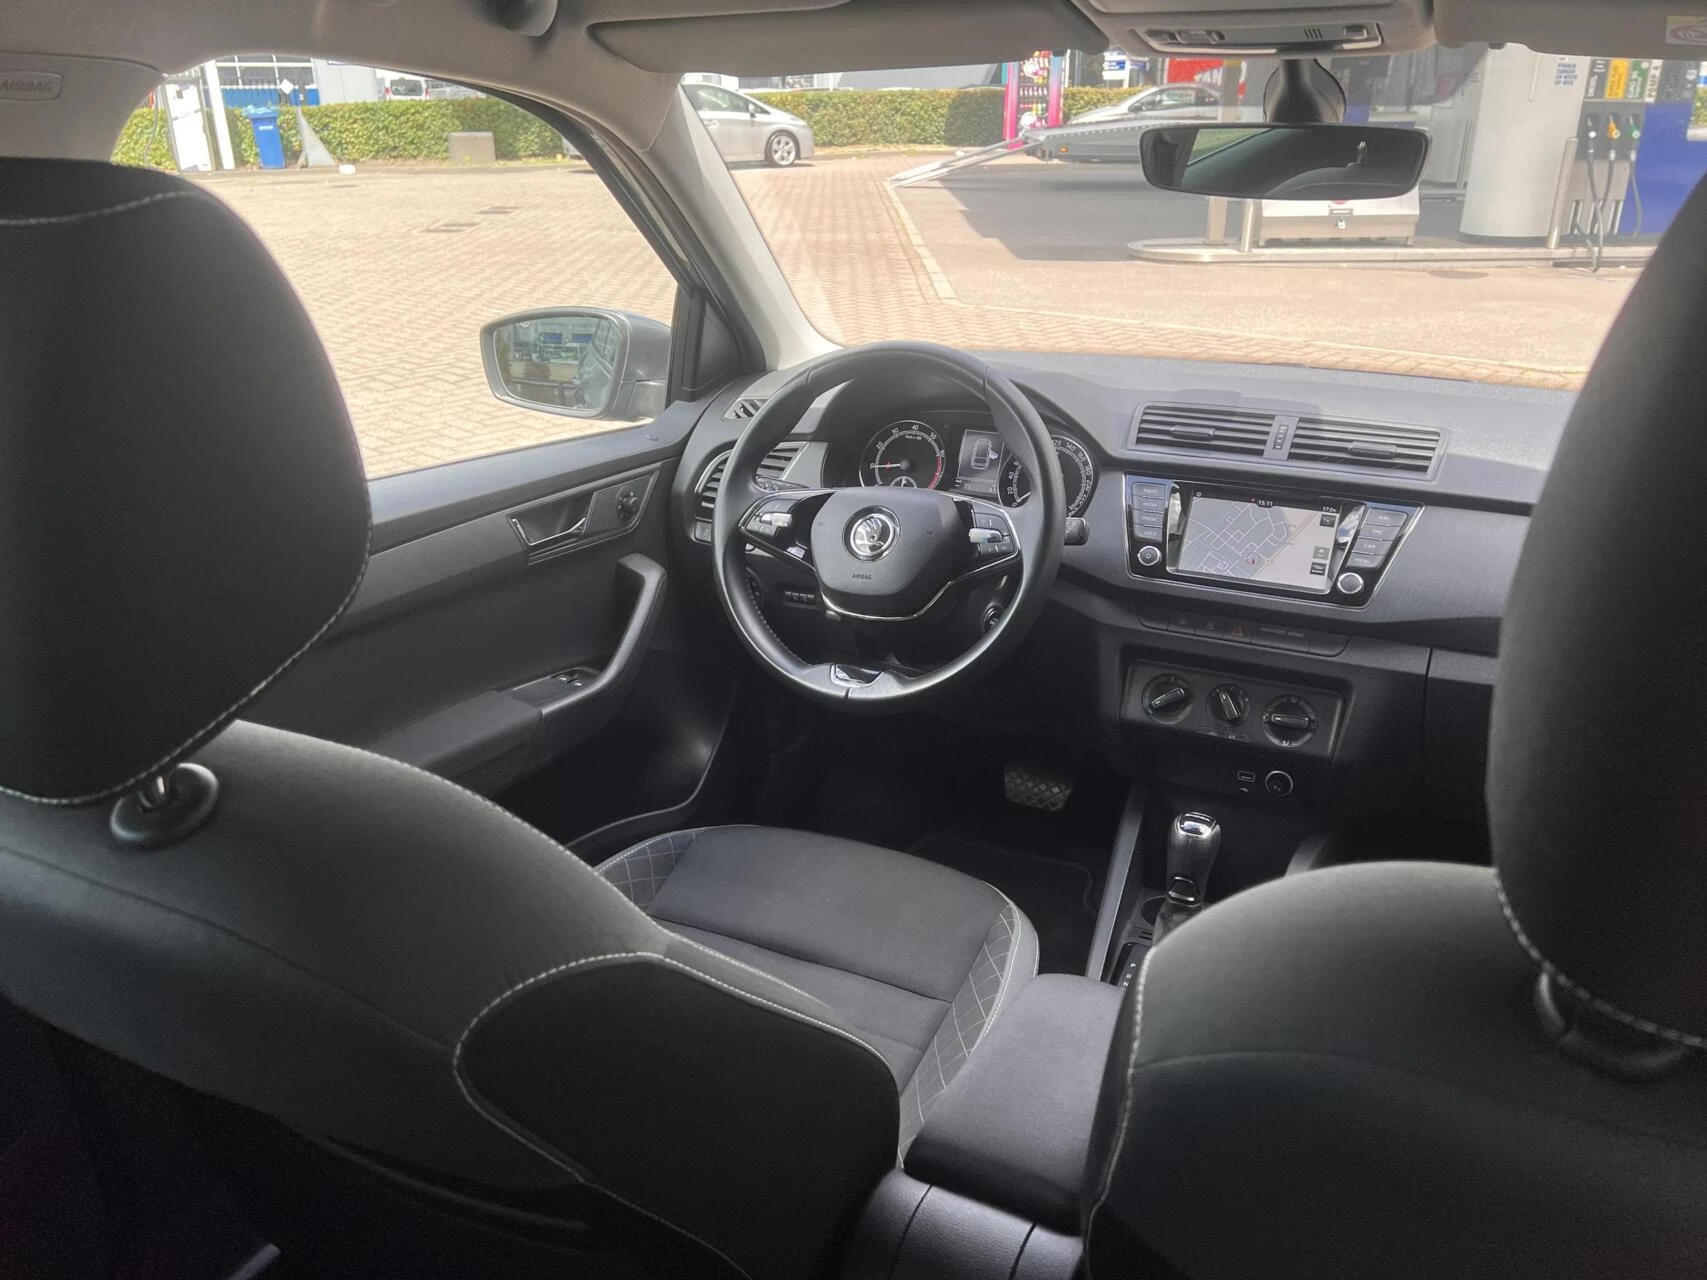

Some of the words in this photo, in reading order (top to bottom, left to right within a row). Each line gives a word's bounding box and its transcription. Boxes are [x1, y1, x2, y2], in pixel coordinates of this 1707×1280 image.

[1647, 74, 1658, 98] POMP
[1066, 442, 1077, 452] 140
[1078, 450, 1087, 462] 160
[1008, 471, 1015, 480] 40
